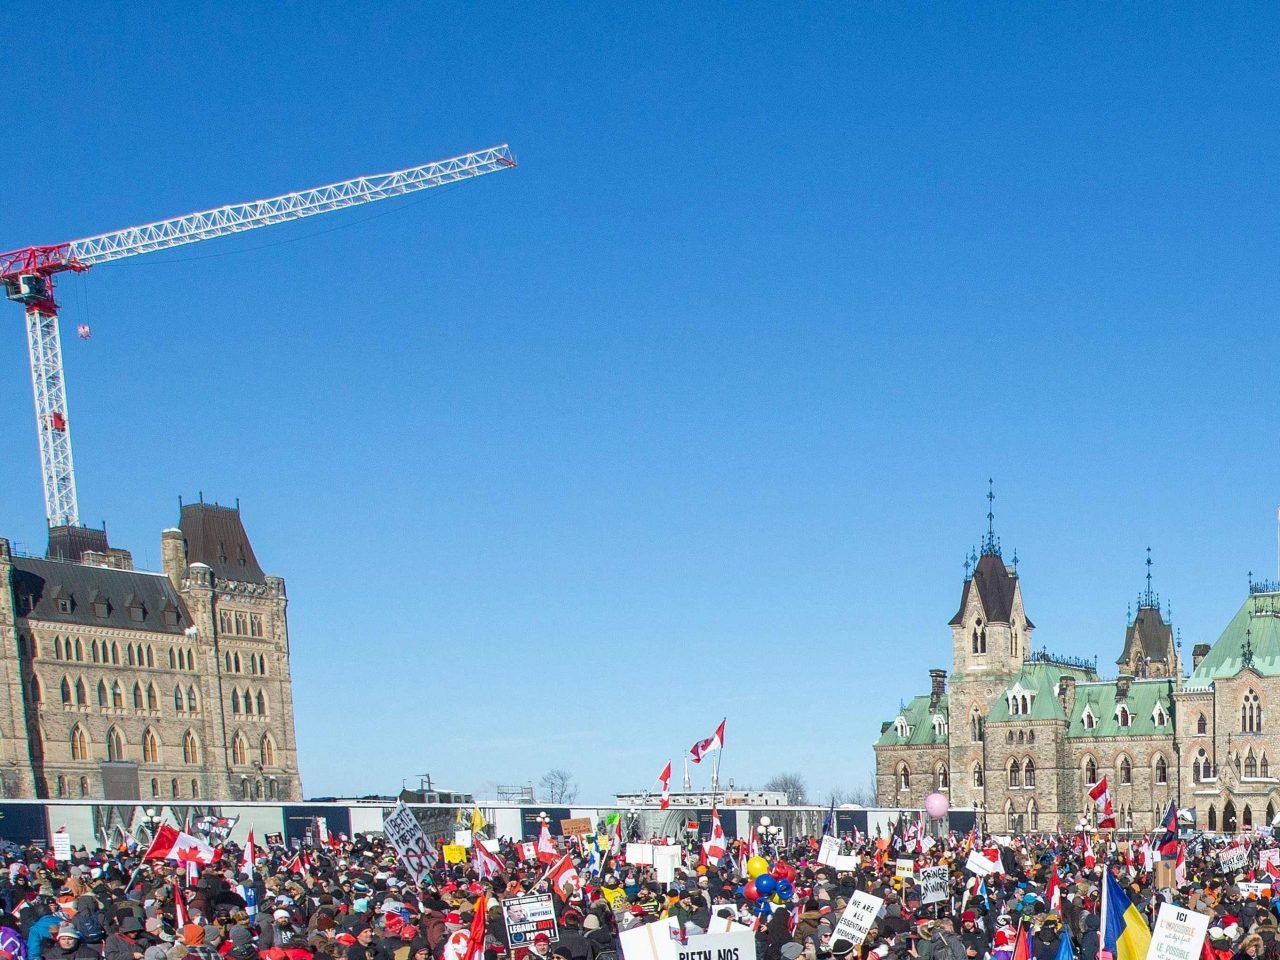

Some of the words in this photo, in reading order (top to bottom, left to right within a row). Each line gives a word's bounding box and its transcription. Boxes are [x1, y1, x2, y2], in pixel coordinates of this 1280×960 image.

[852, 899, 861, 908] WE
[862, 904, 874, 913] ARE
[853, 912, 864, 922] ALL
[1176, 911, 1188, 922] ICI
